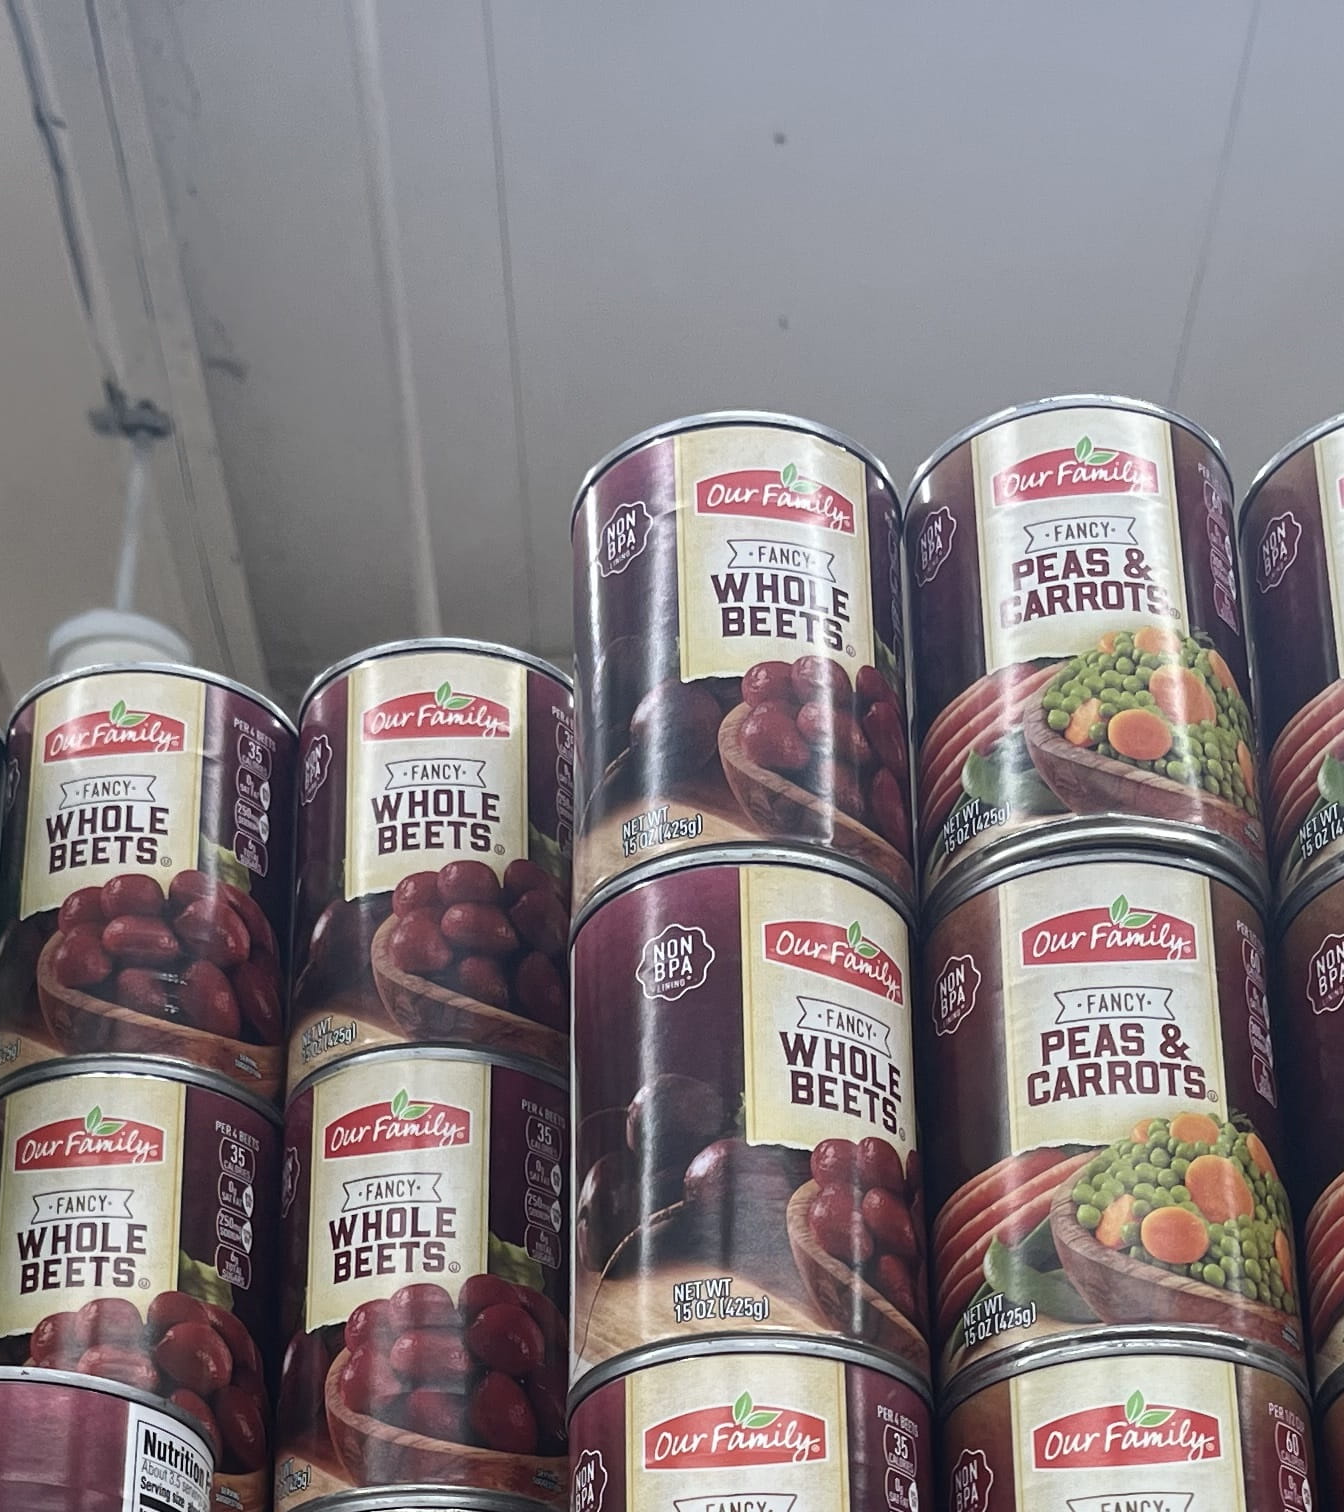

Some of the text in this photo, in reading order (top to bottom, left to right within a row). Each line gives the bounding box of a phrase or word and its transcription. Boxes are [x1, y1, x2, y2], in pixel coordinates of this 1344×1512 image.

[607, 513, 637, 563] NON BPA
[411, 765, 462, 781] FANCY
[372, 792, 500, 825] WHOLE
[378, 824, 491, 856] BEETS
[673, 1278, 731, 1303] NET WT
[675, 1293, 769, 1322] 15 OZ (425g)
[143, 1430, 205, 1482] Nutrition
